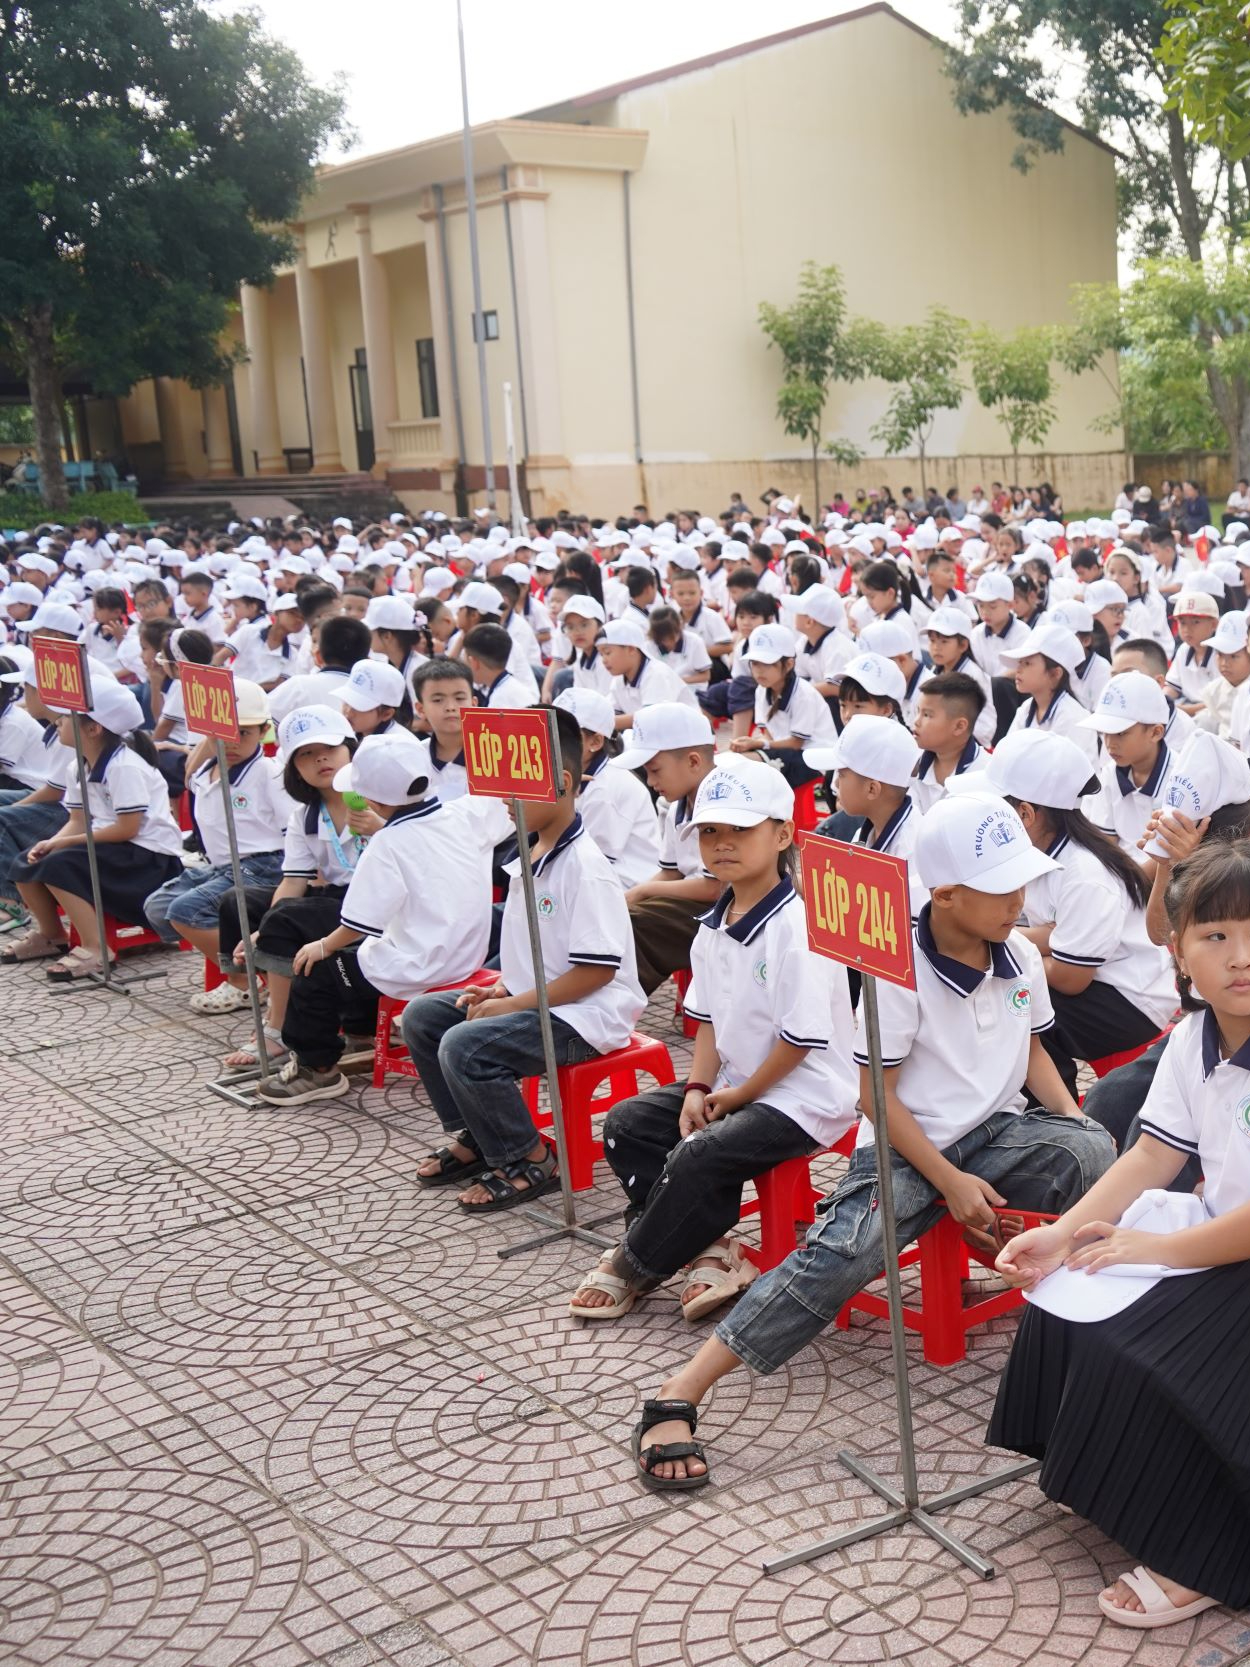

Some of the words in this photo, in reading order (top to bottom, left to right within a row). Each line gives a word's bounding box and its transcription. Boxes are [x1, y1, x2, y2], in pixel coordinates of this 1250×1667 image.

[38, 653, 58, 690] LỚP
[59, 663, 80, 695] 2A1
[185, 675, 207, 720] LỚP
[208, 685, 233, 726] 2A2
[468, 723, 503, 778] LỚP
[508, 734, 544, 781] 2A3
[811, 858, 850, 937] LỚP
[856, 882, 898, 956] 2A4
